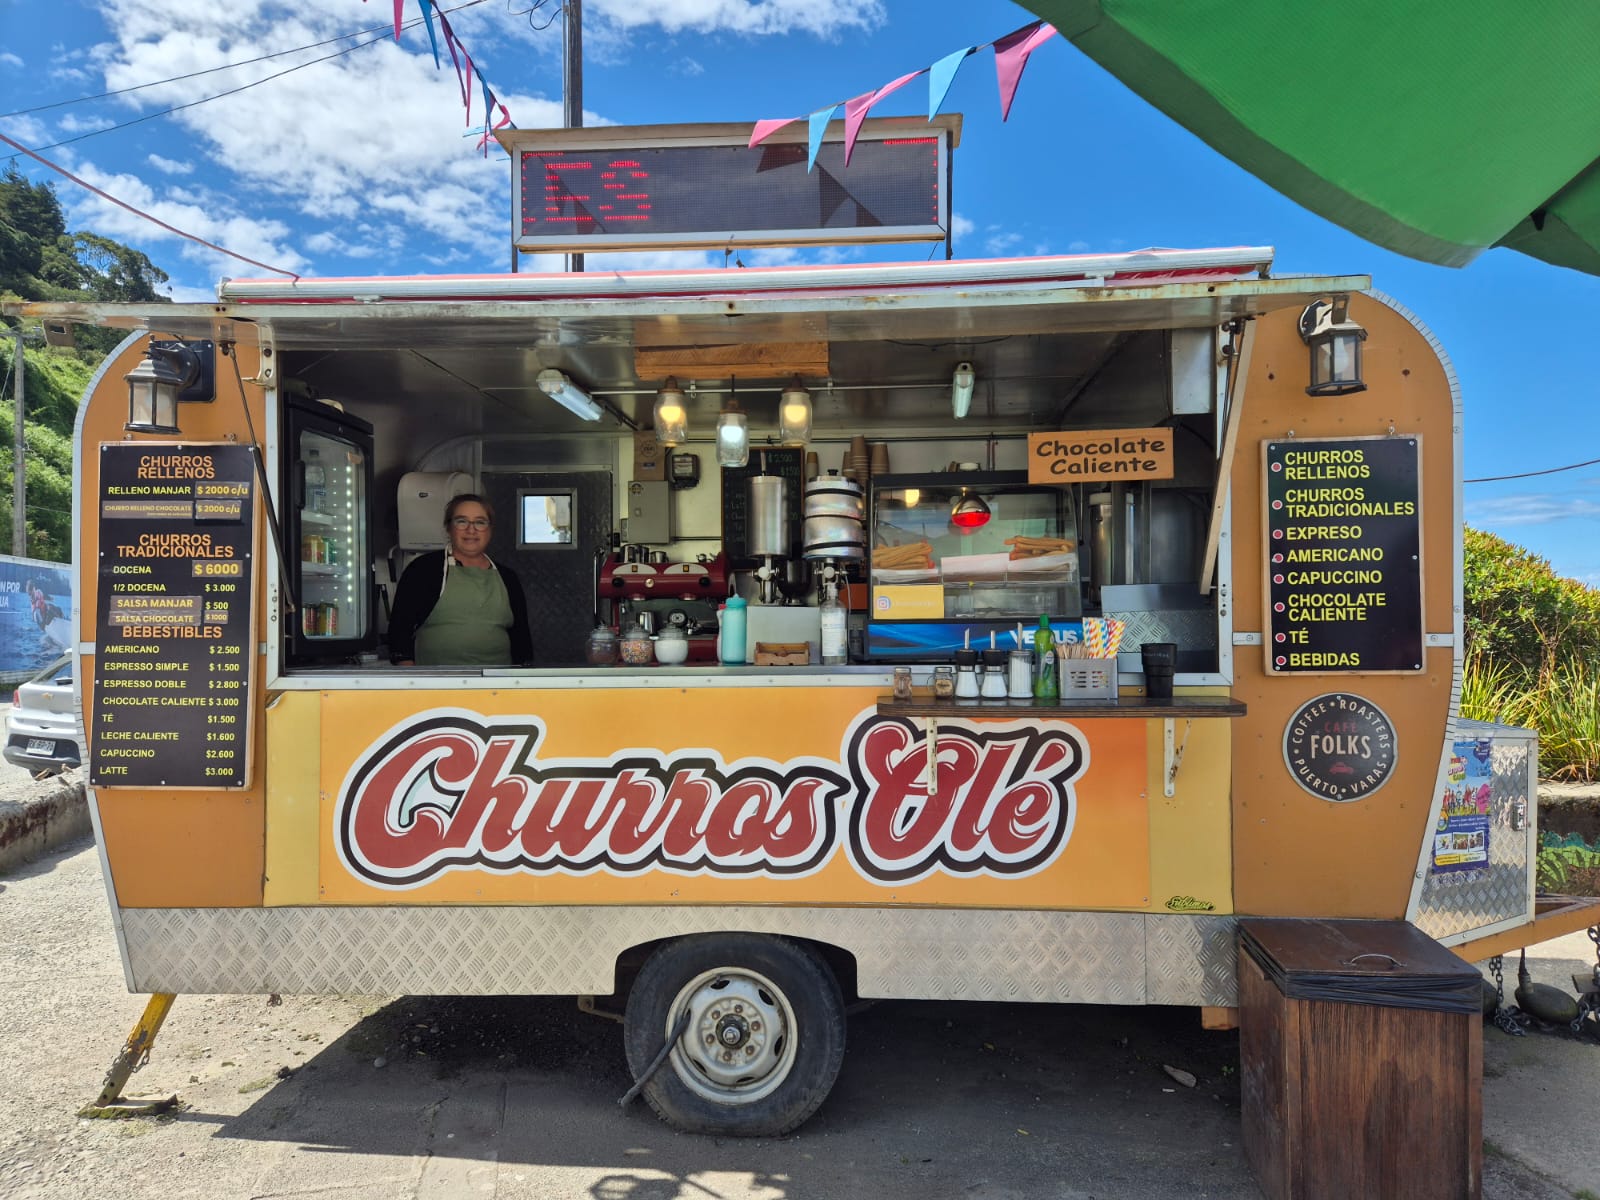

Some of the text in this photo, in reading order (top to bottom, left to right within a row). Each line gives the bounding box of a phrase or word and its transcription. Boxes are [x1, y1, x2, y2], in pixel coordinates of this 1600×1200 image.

[1036, 437, 1166, 458] Chocolate
[140, 456, 213, 468] CHURROS
[1284, 450, 1364, 466] CHURROS
[138, 467, 215, 479] RELLENOS
[1049, 457, 1158, 476] Caliente
[1285, 465, 1370, 480] RELLENOS
[108, 486, 150, 494] RELLENO
[152, 486, 191, 494] MANJAR
[205, 486, 230, 494] 2000
[232, 485, 248, 496] c/u
[1285, 488, 1364, 503] CHURROS
[225, 504, 240, 514] c/u
[1286, 502, 1415, 518] TRADICIONALES
[1286, 525, 1362, 540] EXPRESO
[139, 534, 212, 546] CHURROS
[117, 546, 234, 558] TRADICIONALES
[1286, 547, 1384, 563] AMERICANO
[113, 564, 239, 575] DOCENA $ 6000
[1287, 570, 1382, 584] CAPUCCINO
[113, 584, 236, 592] 1/2 DOCENA $ 3.000
[117, 600, 148, 608] SALSA
[150, 600, 193, 608] MANJAR
[205, 602, 210, 610] $
[1288, 592, 1386, 607] CHOCOLATE
[1288, 607, 1367, 622] CALIENTE
[123, 626, 222, 639] BEBESTIBLES
[1009, 630, 1078, 644] VEUS
[1289, 628, 1310, 644] TÉ
[105, 646, 160, 654] AMERICANO
[217, 646, 240, 654] 2.500
[1290, 652, 1360, 666] BEBIDAS
[104, 663, 153, 671] ESPRESSO
[156, 663, 189, 671] SIMPLE
[217, 663, 240, 671] 1.500
[104, 680, 153, 688] ESPRESSO
[216, 681, 239, 689] 2.800
[103, 697, 159, 705] CHOCOLATE
[161, 698, 206, 706] CALIENTE
[207, 715, 235, 724] $1.500
[1292, 699, 1390, 749] COFFEE ROASTERS
[134, 732, 180, 740] CALIENTE
[206, 732, 235, 741] $1.600
[1310, 735, 1372, 759] FOLKS
[100, 749, 234, 759] CAPUCCINO $2.600
[205, 768, 233, 776] $3.000
[1295, 758, 1387, 795] PUERTO VARAS
[340, 714, 1083, 886] Churros Olé
